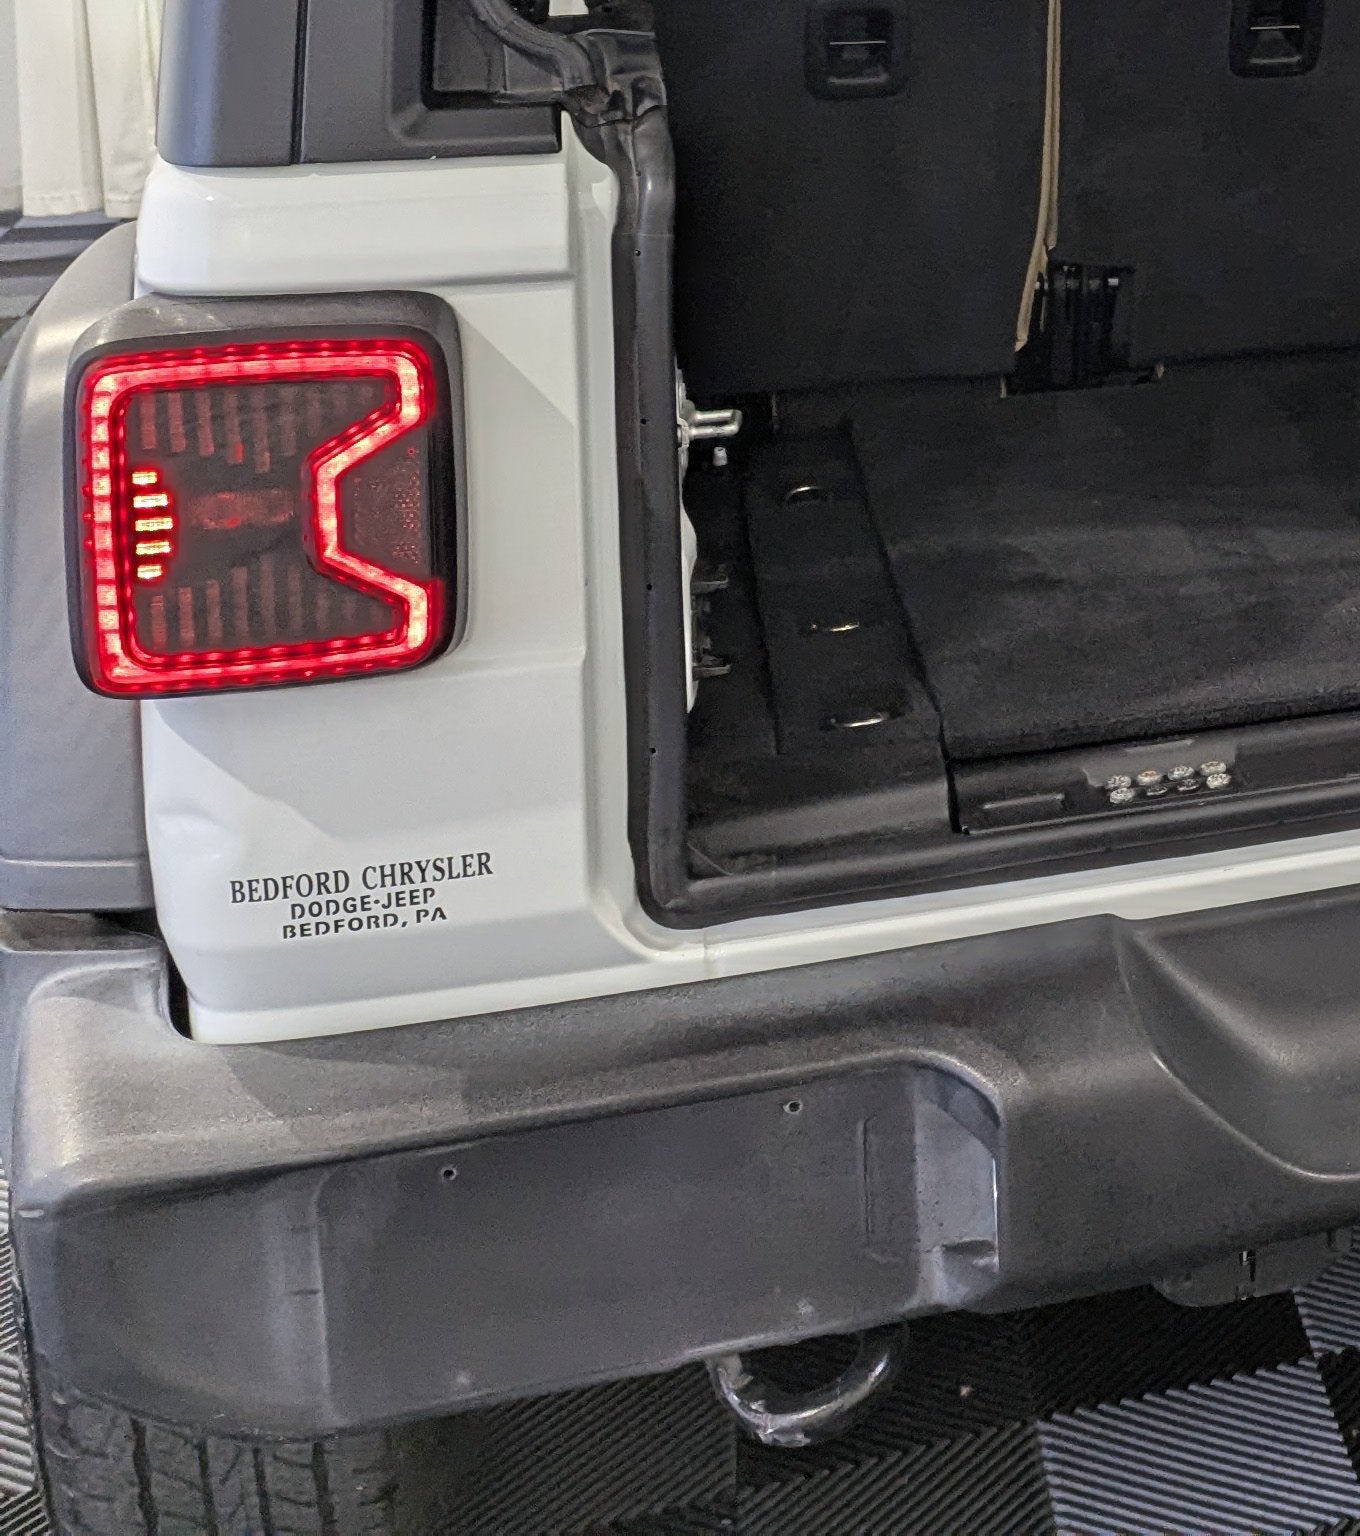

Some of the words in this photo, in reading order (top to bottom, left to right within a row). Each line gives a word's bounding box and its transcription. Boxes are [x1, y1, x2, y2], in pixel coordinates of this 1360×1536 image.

[230, 869, 350, 904] BEDFORD
[361, 851, 494, 890] CHRYSLER
[282, 912, 408, 939] BEDFORD,
[415, 906, 447, 924] PA
